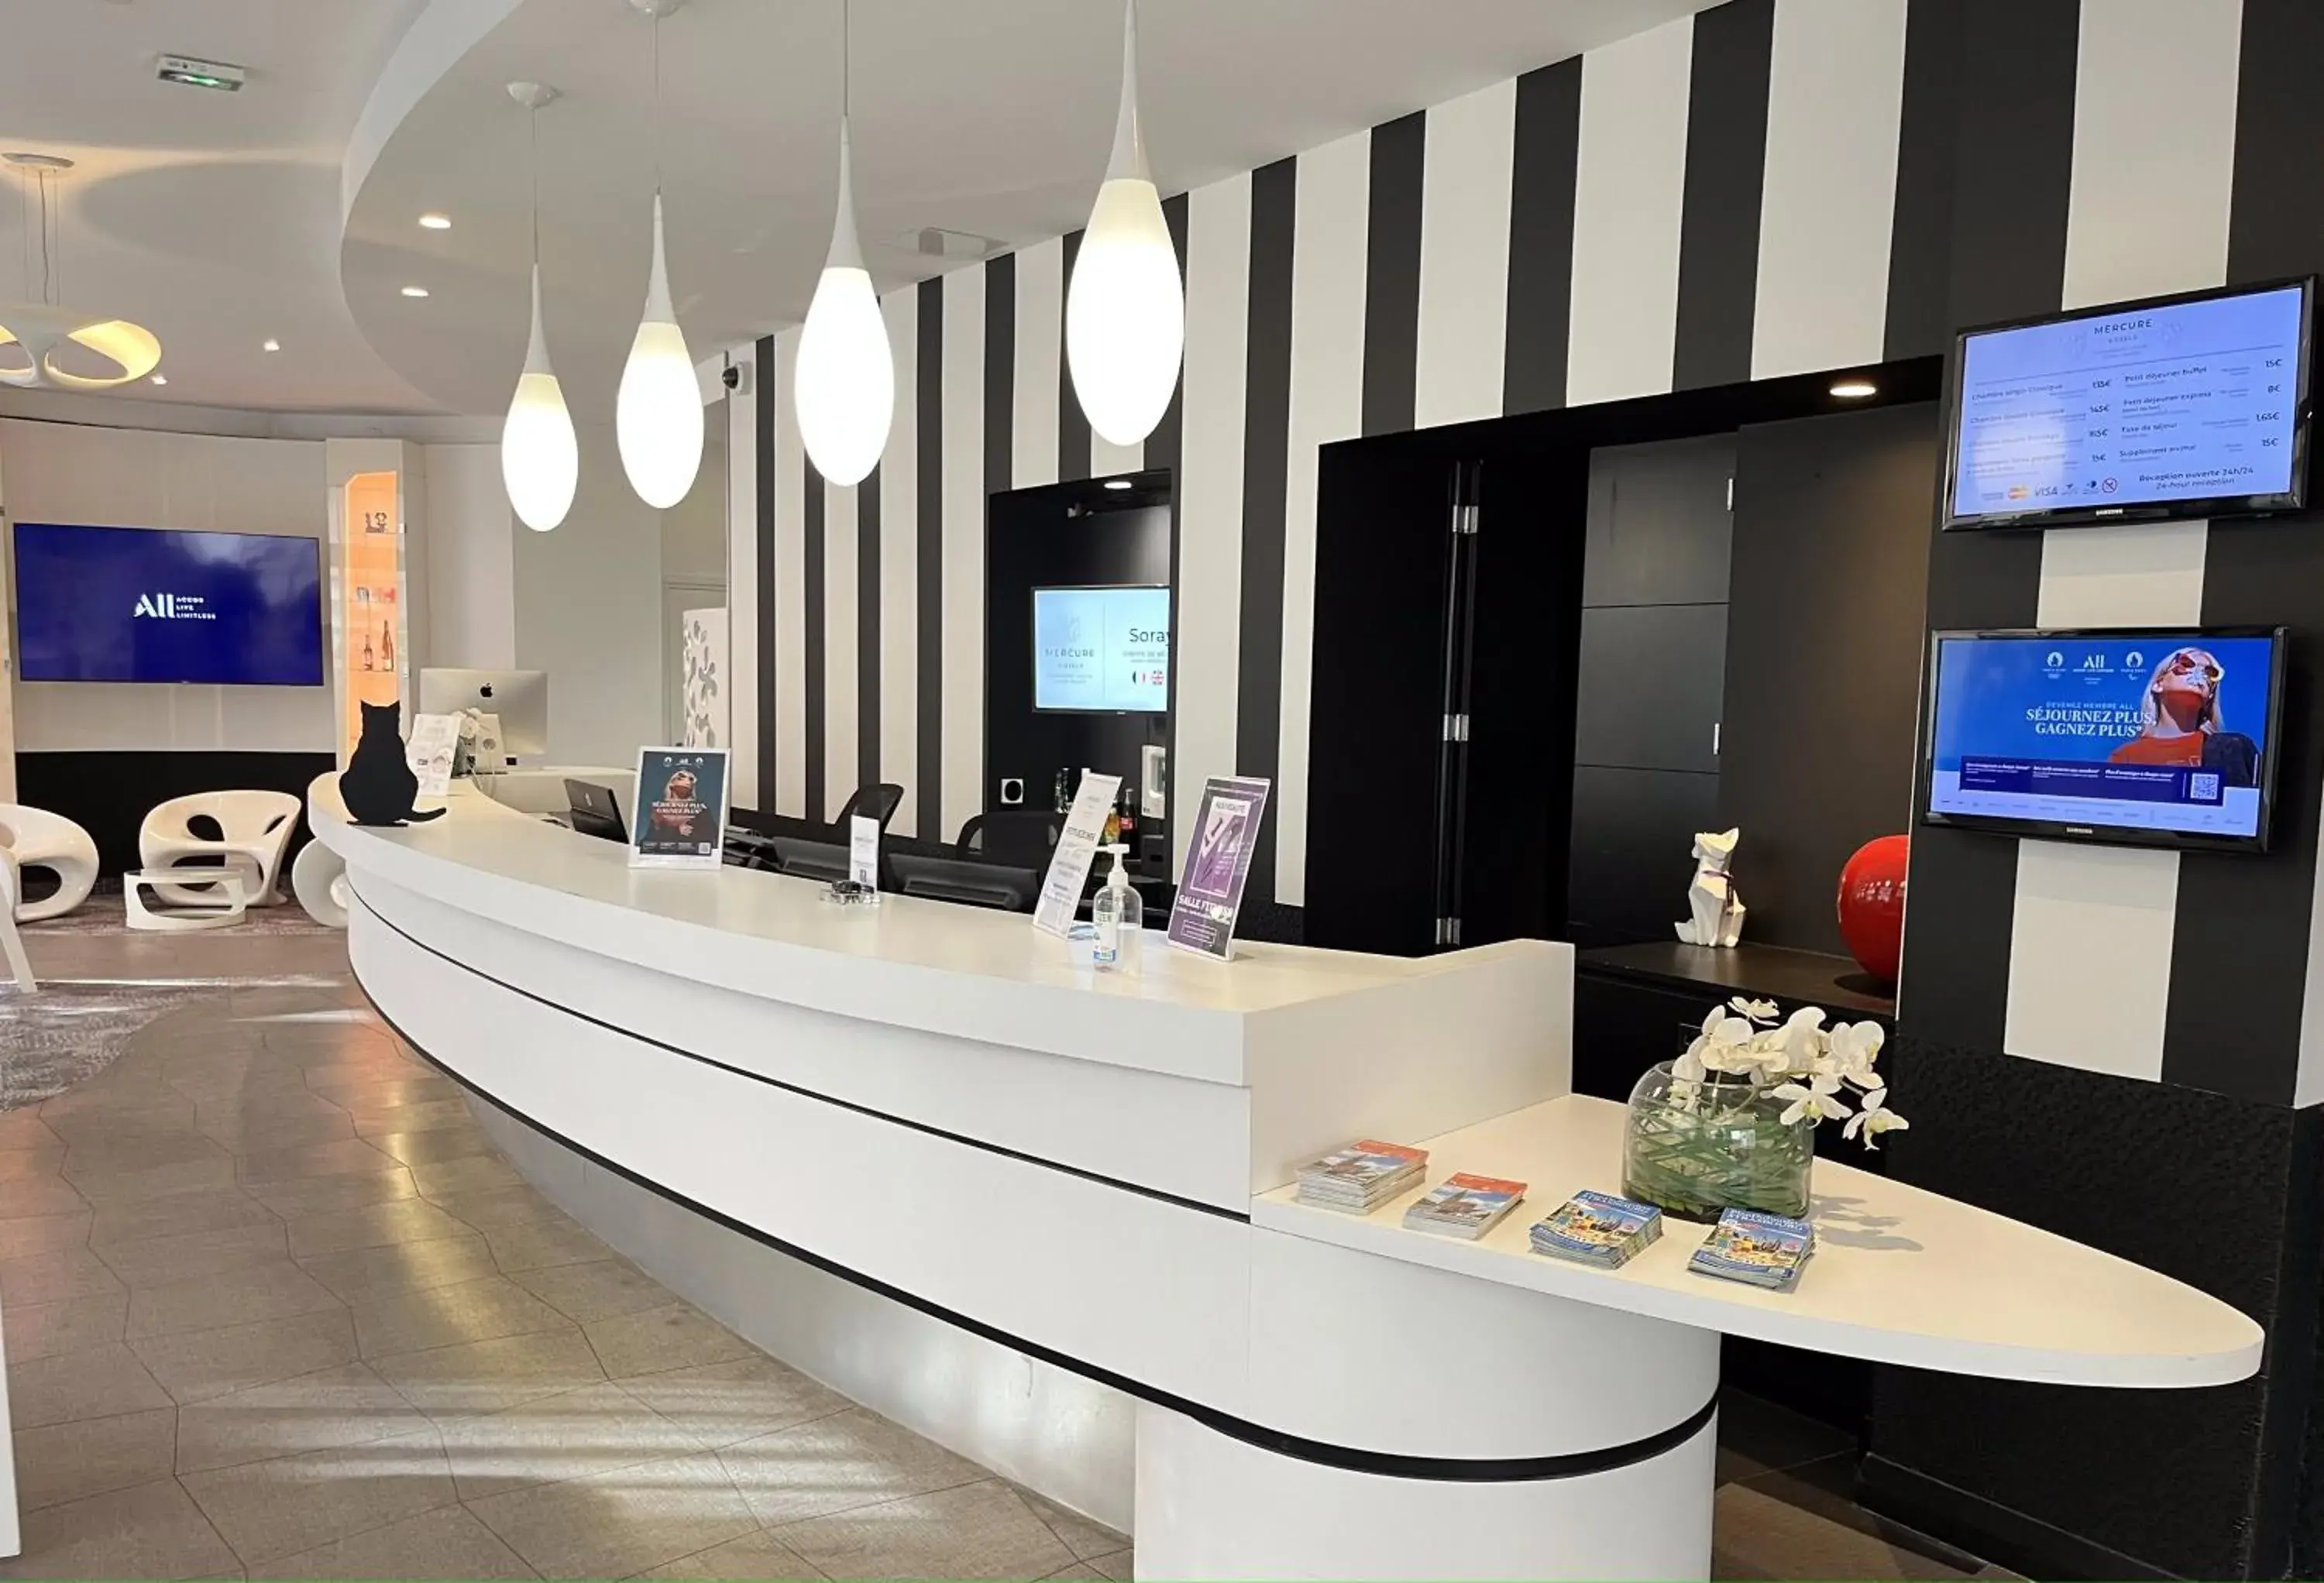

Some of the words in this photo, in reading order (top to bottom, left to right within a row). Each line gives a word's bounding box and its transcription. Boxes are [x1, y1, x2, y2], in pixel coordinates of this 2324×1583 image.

[2094, 318, 2153, 335] MERCURE
[2265, 359, 2282, 368] 15€
[2267, 384, 2281, 393] 8€
[2261, 438, 2279, 447] 15€
[2034, 486, 2058, 496] VISA
[1045, 648, 1095, 658] MERCURE
[2026, 706, 2112, 723] SÉJOURNEZ
[2035, 722, 2095, 736] GAGNEZ
